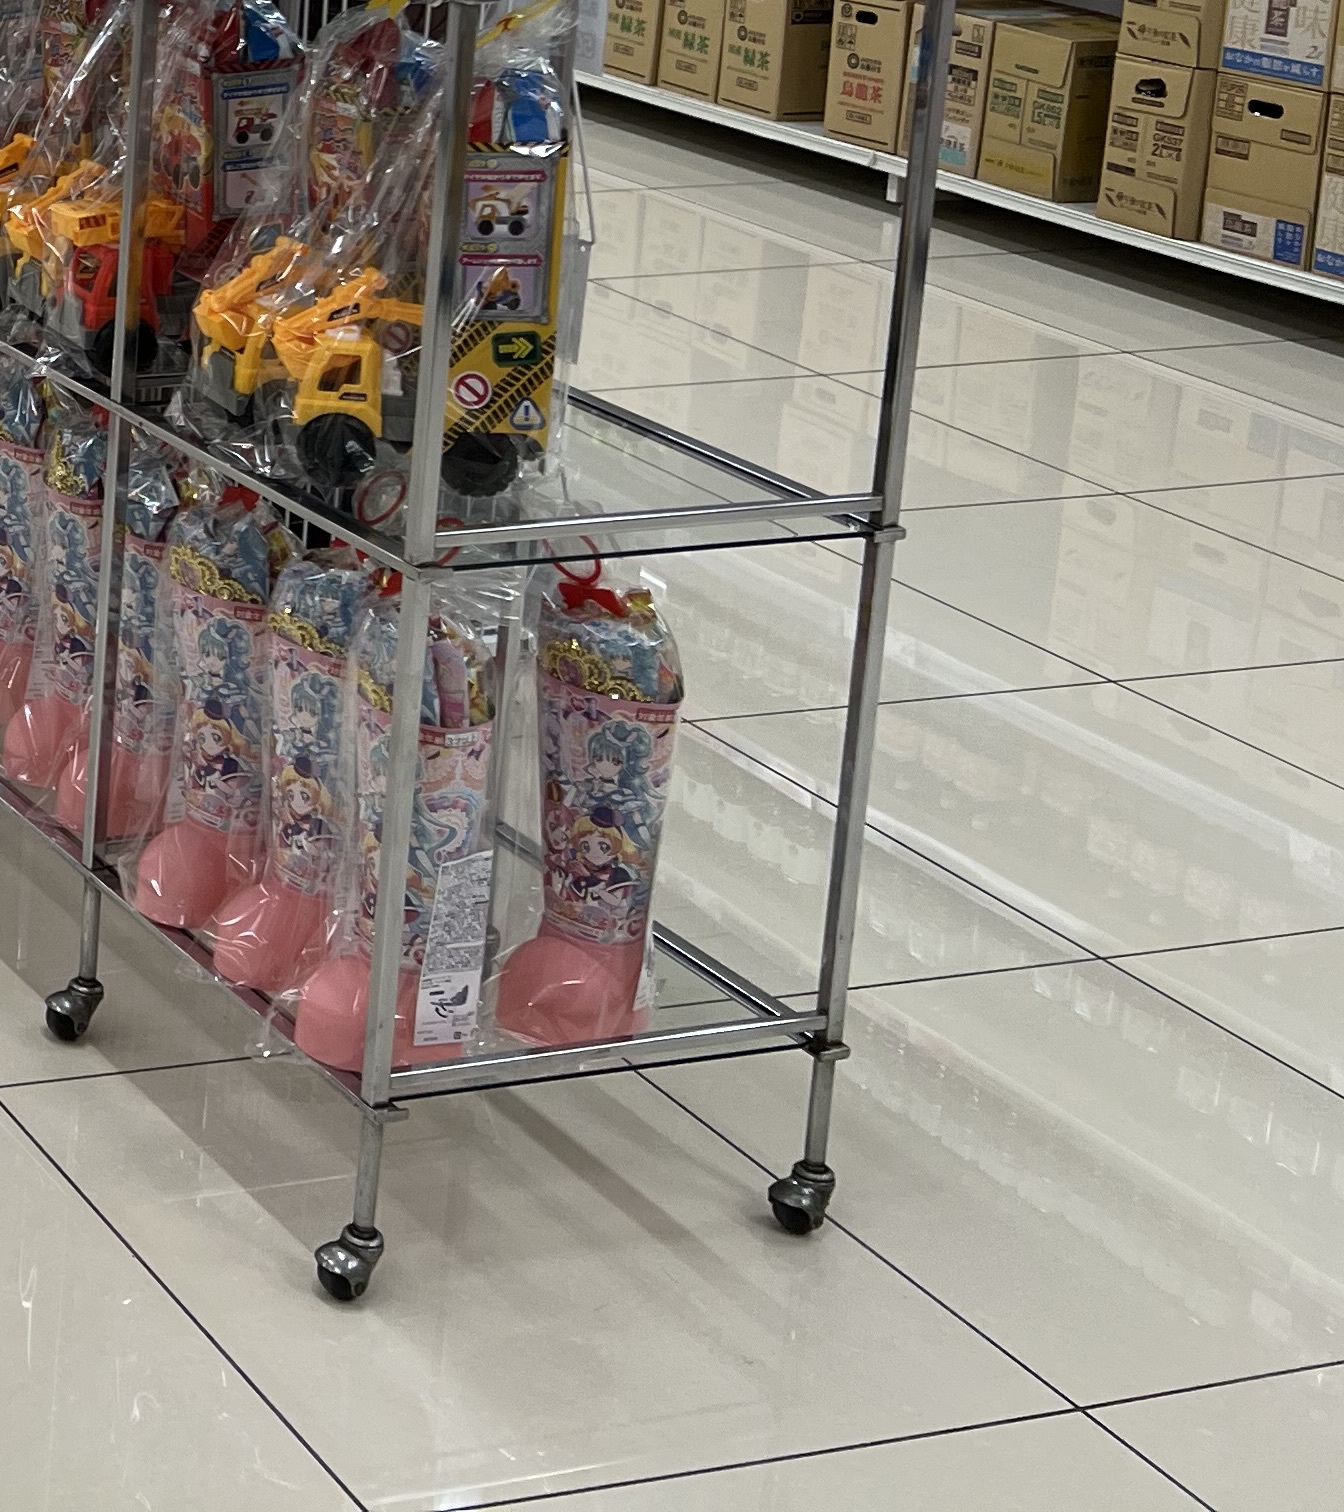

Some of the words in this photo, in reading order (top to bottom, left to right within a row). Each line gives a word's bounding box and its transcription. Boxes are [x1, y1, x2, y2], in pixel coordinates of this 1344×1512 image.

[619, 14, 647, 38] 緑茶
[681, 29, 711, 55] 緑茶
[742, 47, 771, 72] 緑茶
[839, 79, 884, 105] 烏龍茶
